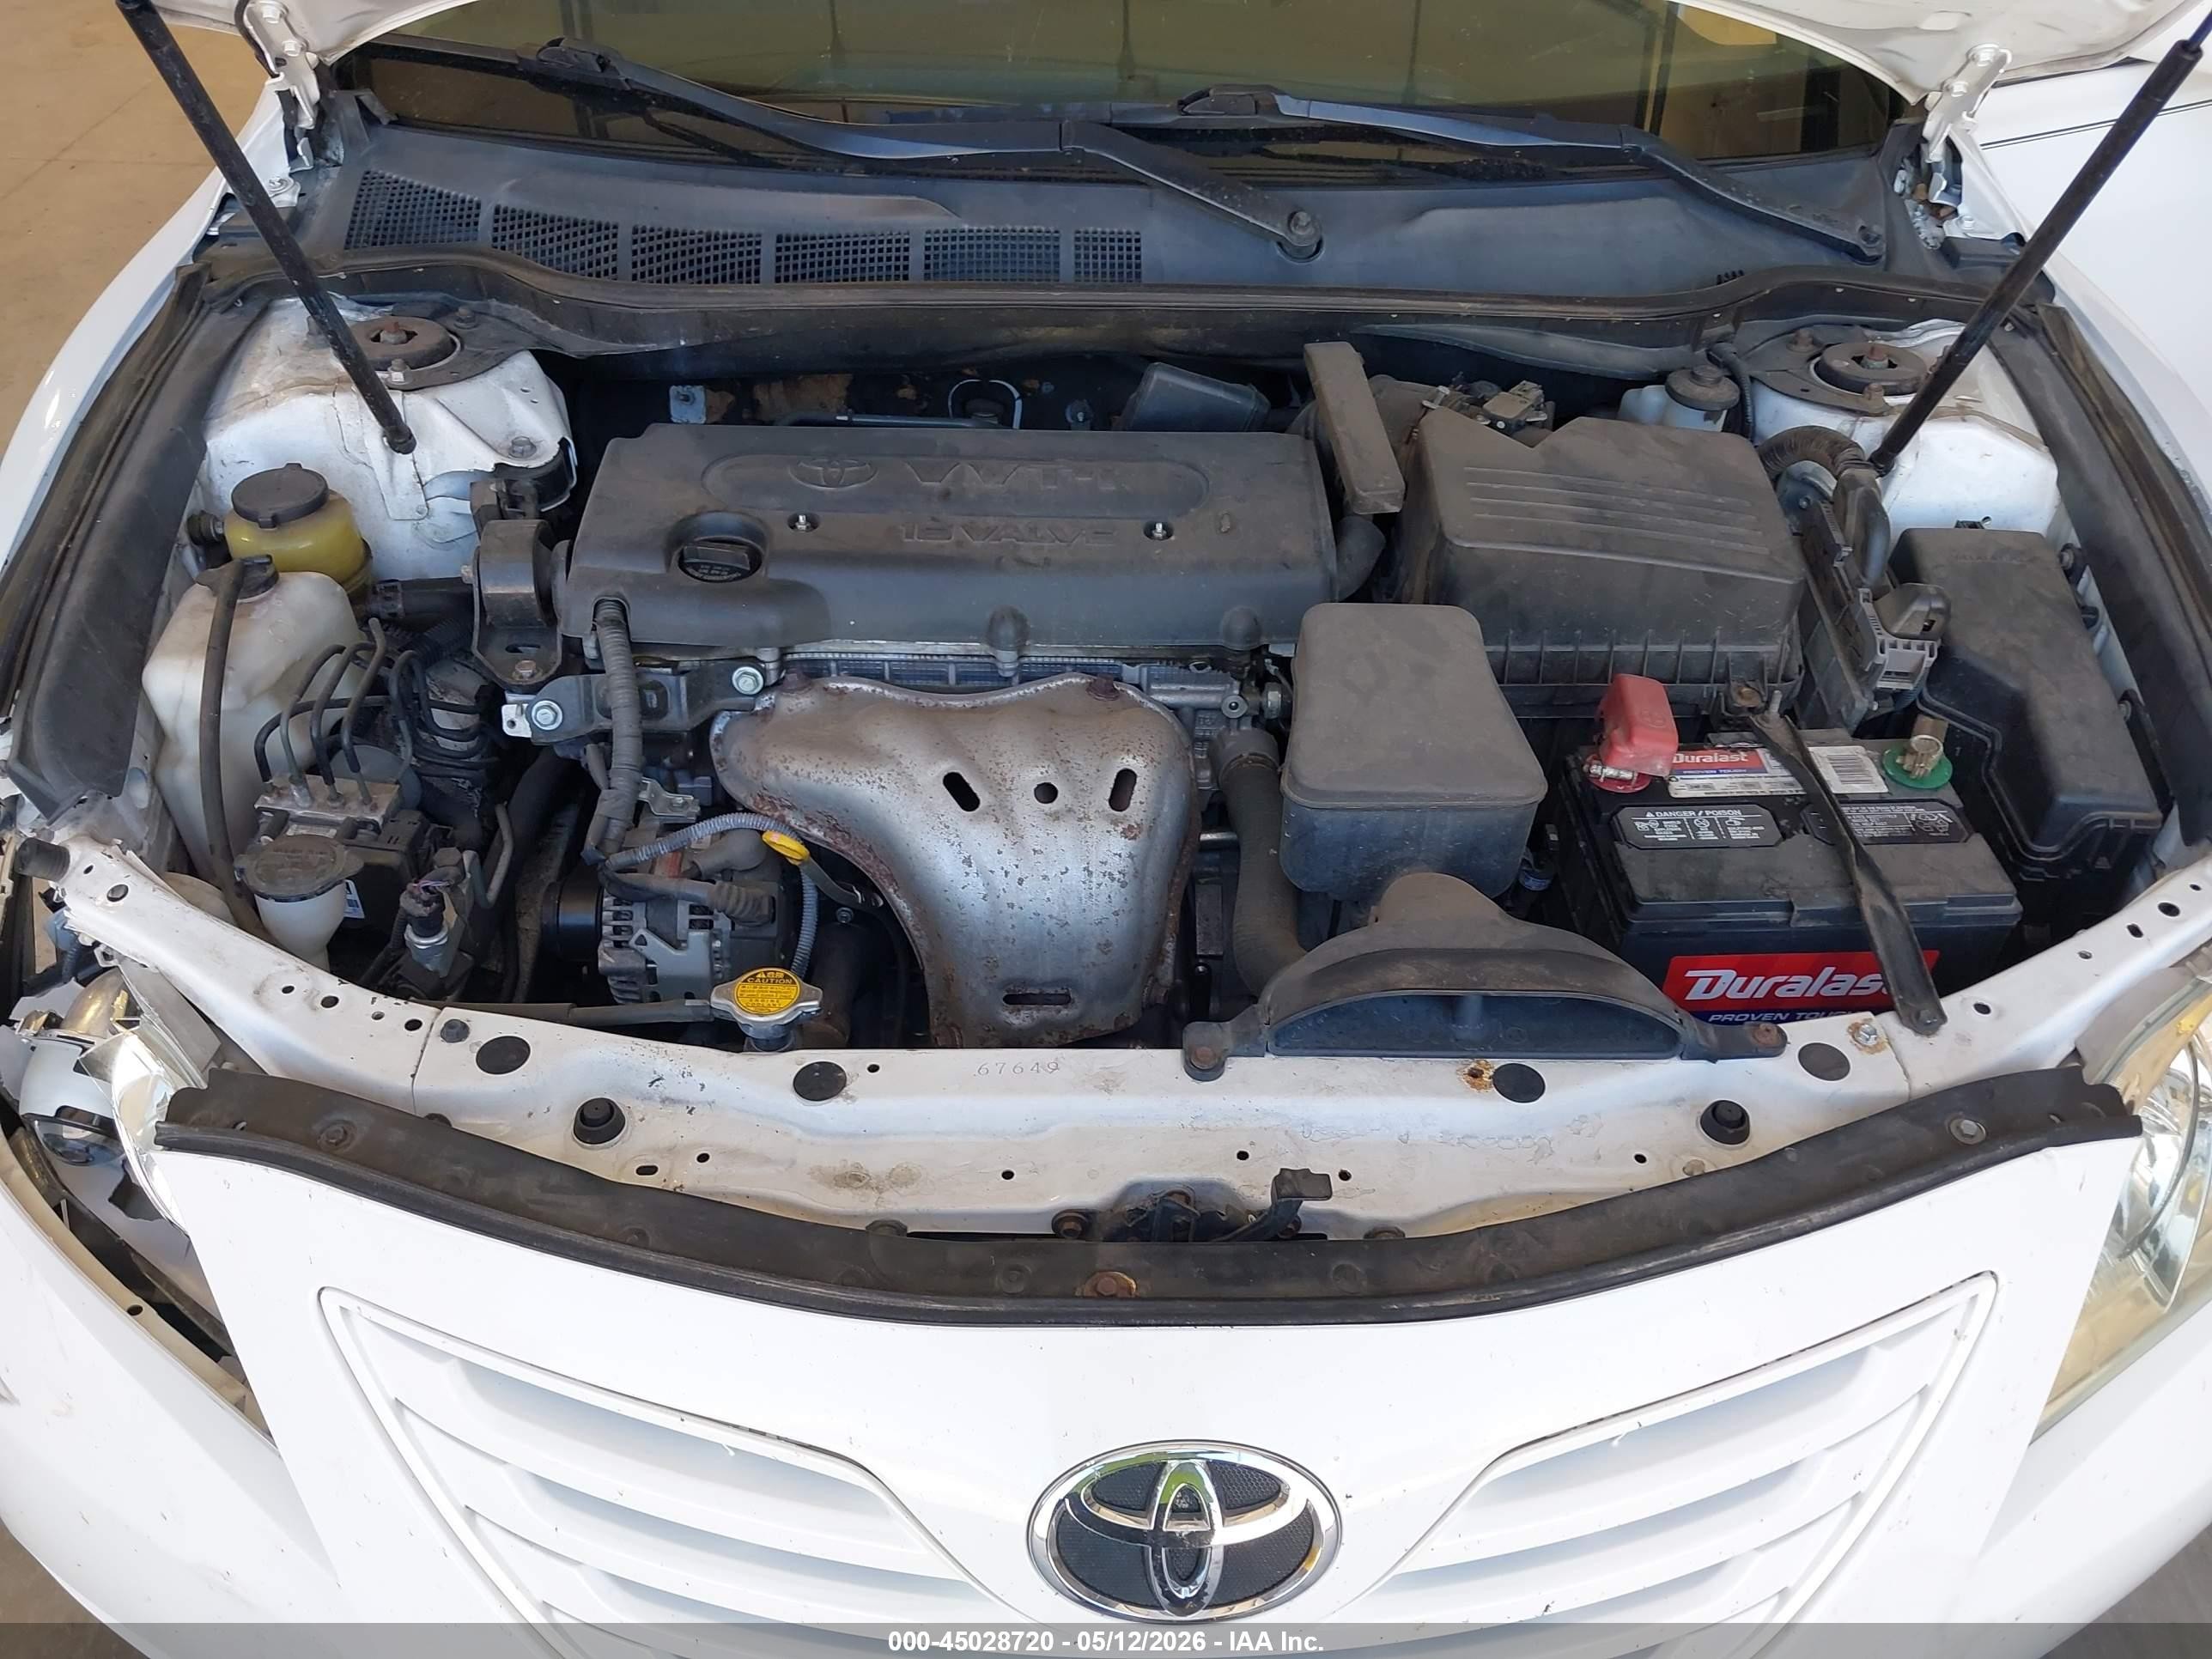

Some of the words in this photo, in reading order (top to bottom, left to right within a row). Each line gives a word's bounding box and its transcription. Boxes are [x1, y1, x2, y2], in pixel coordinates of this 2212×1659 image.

[1672, 750, 1750, 764] Duralast
[1684, 967, 1888, 1000] Duralas
[1708, 1012, 1791, 1023] PROVEN
[1796, 1011, 1852, 1021] TOU
[977, 1061, 1060, 1075] 67649
